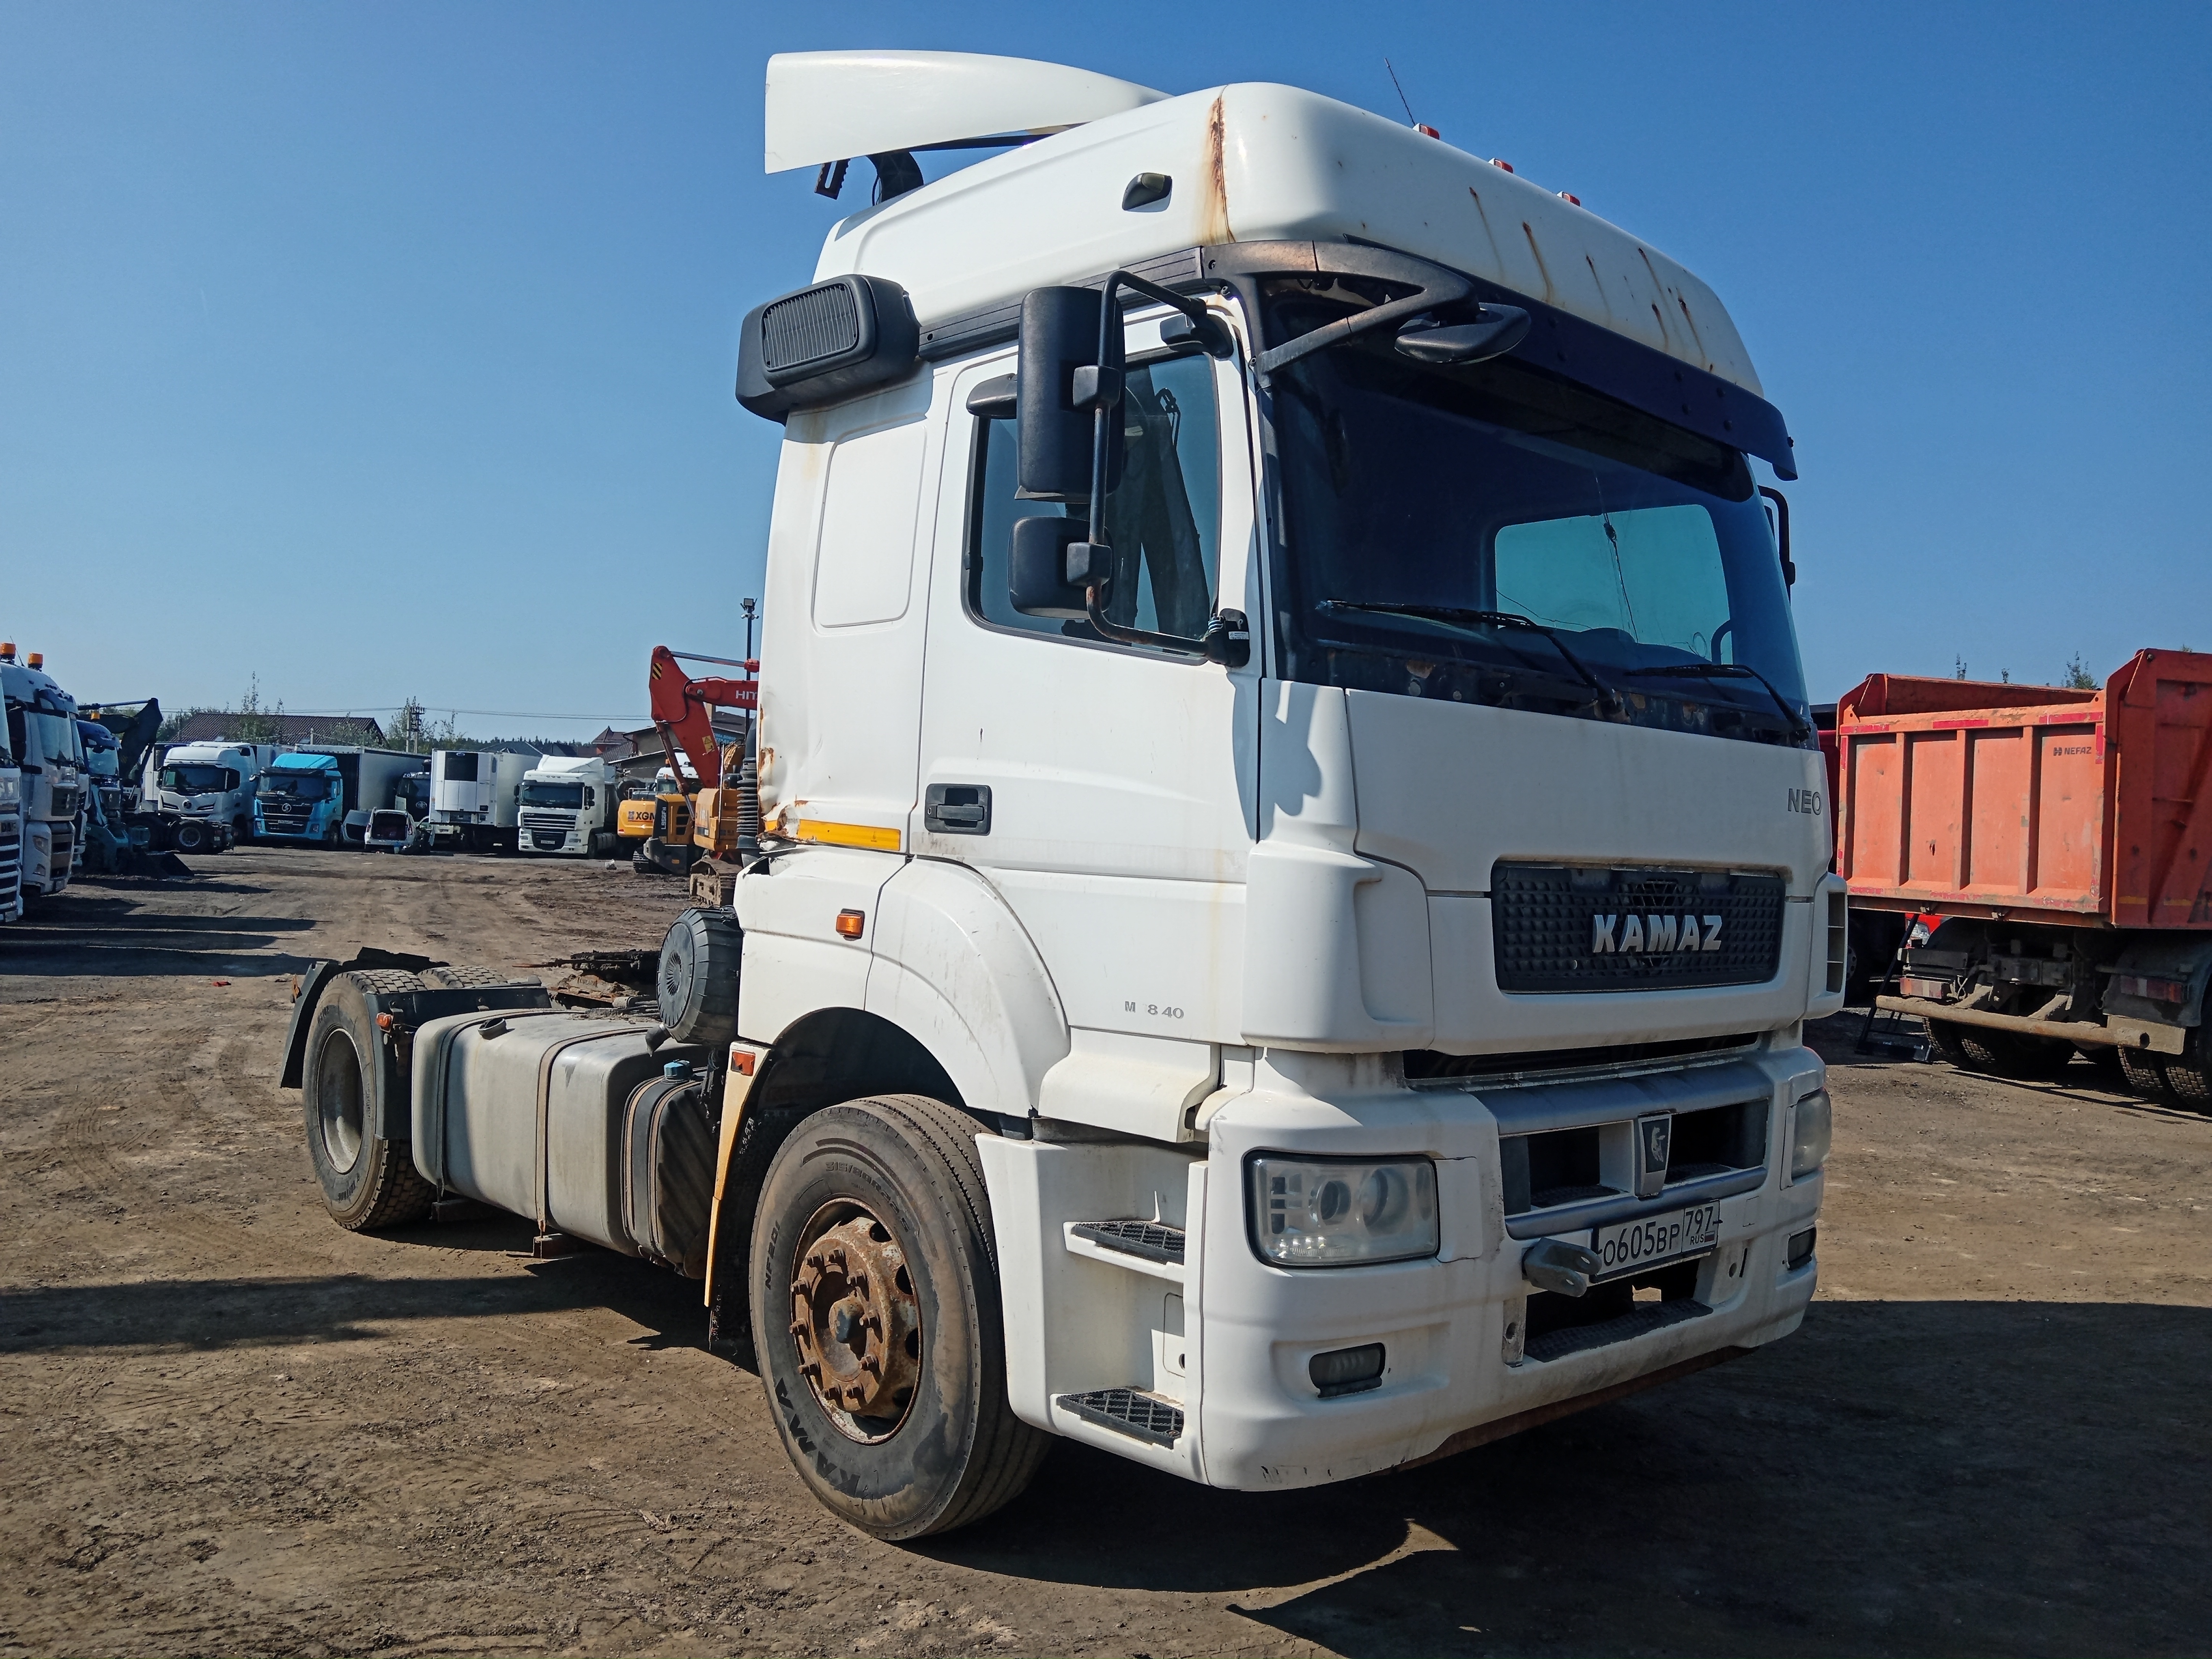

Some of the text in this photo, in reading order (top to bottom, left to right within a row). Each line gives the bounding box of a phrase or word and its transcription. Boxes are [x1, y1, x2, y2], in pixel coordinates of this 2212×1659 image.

[736, 690, 758, 700] HIT
[2065, 747, 2092, 755] NEFAZ
[1788, 788, 1822, 815] NEO
[1593, 915, 1722, 953] KAMAZ
[1125, 1001, 1136, 1012] M
[1685, 1206, 1714, 1236] 797
[1690, 1234, 1704, 1245] RUS
[765, 1220, 780, 1290] NF201
[775, 1377, 860, 1497] KAMA
